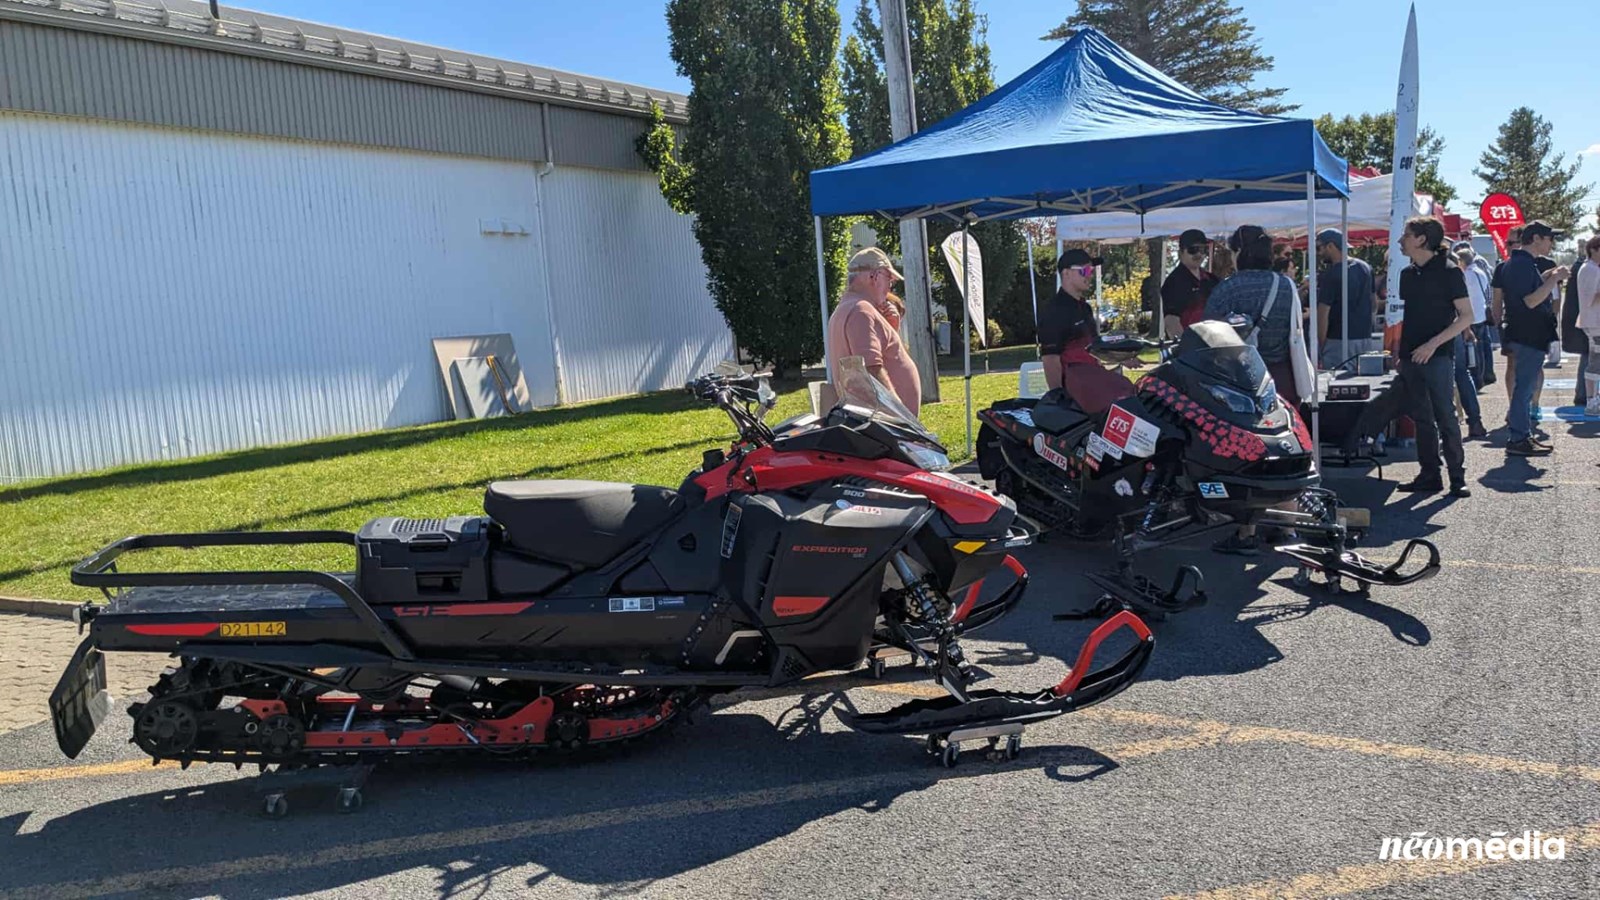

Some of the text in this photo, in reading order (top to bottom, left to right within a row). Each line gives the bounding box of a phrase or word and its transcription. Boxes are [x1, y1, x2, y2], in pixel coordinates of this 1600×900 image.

[1109, 416, 1130, 433] ÉTS
[1199, 483, 1225, 495] SAE
[791, 545, 868, 554] EXPEDITION
[221, 622, 285, 636] D21142
